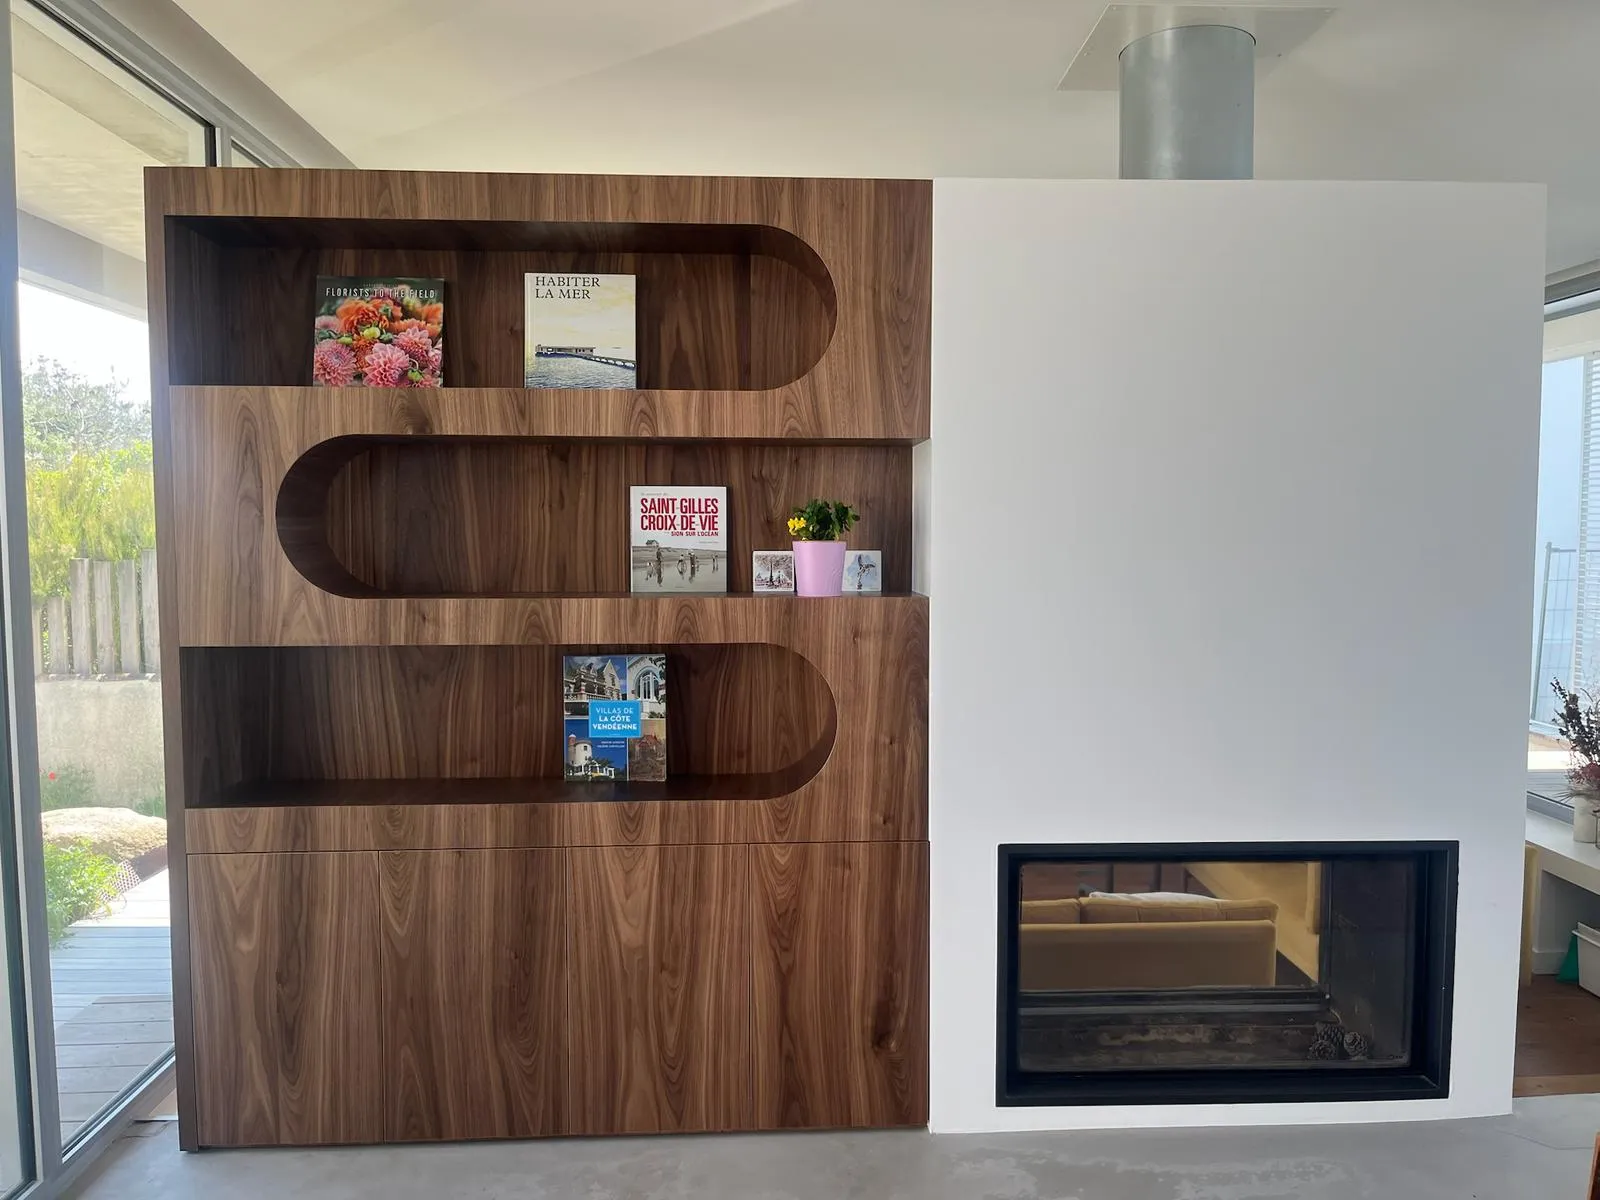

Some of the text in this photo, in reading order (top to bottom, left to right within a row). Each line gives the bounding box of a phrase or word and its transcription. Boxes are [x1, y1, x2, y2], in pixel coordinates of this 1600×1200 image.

[535, 276, 600, 287] HABITER
[326, 287, 436, 299] FLORISTS TO THE FIELD
[535, 289, 591, 299] LA MER
[610, 714, 631, 722] CÔTE
[592, 722, 637, 730] VENDÉENNE
